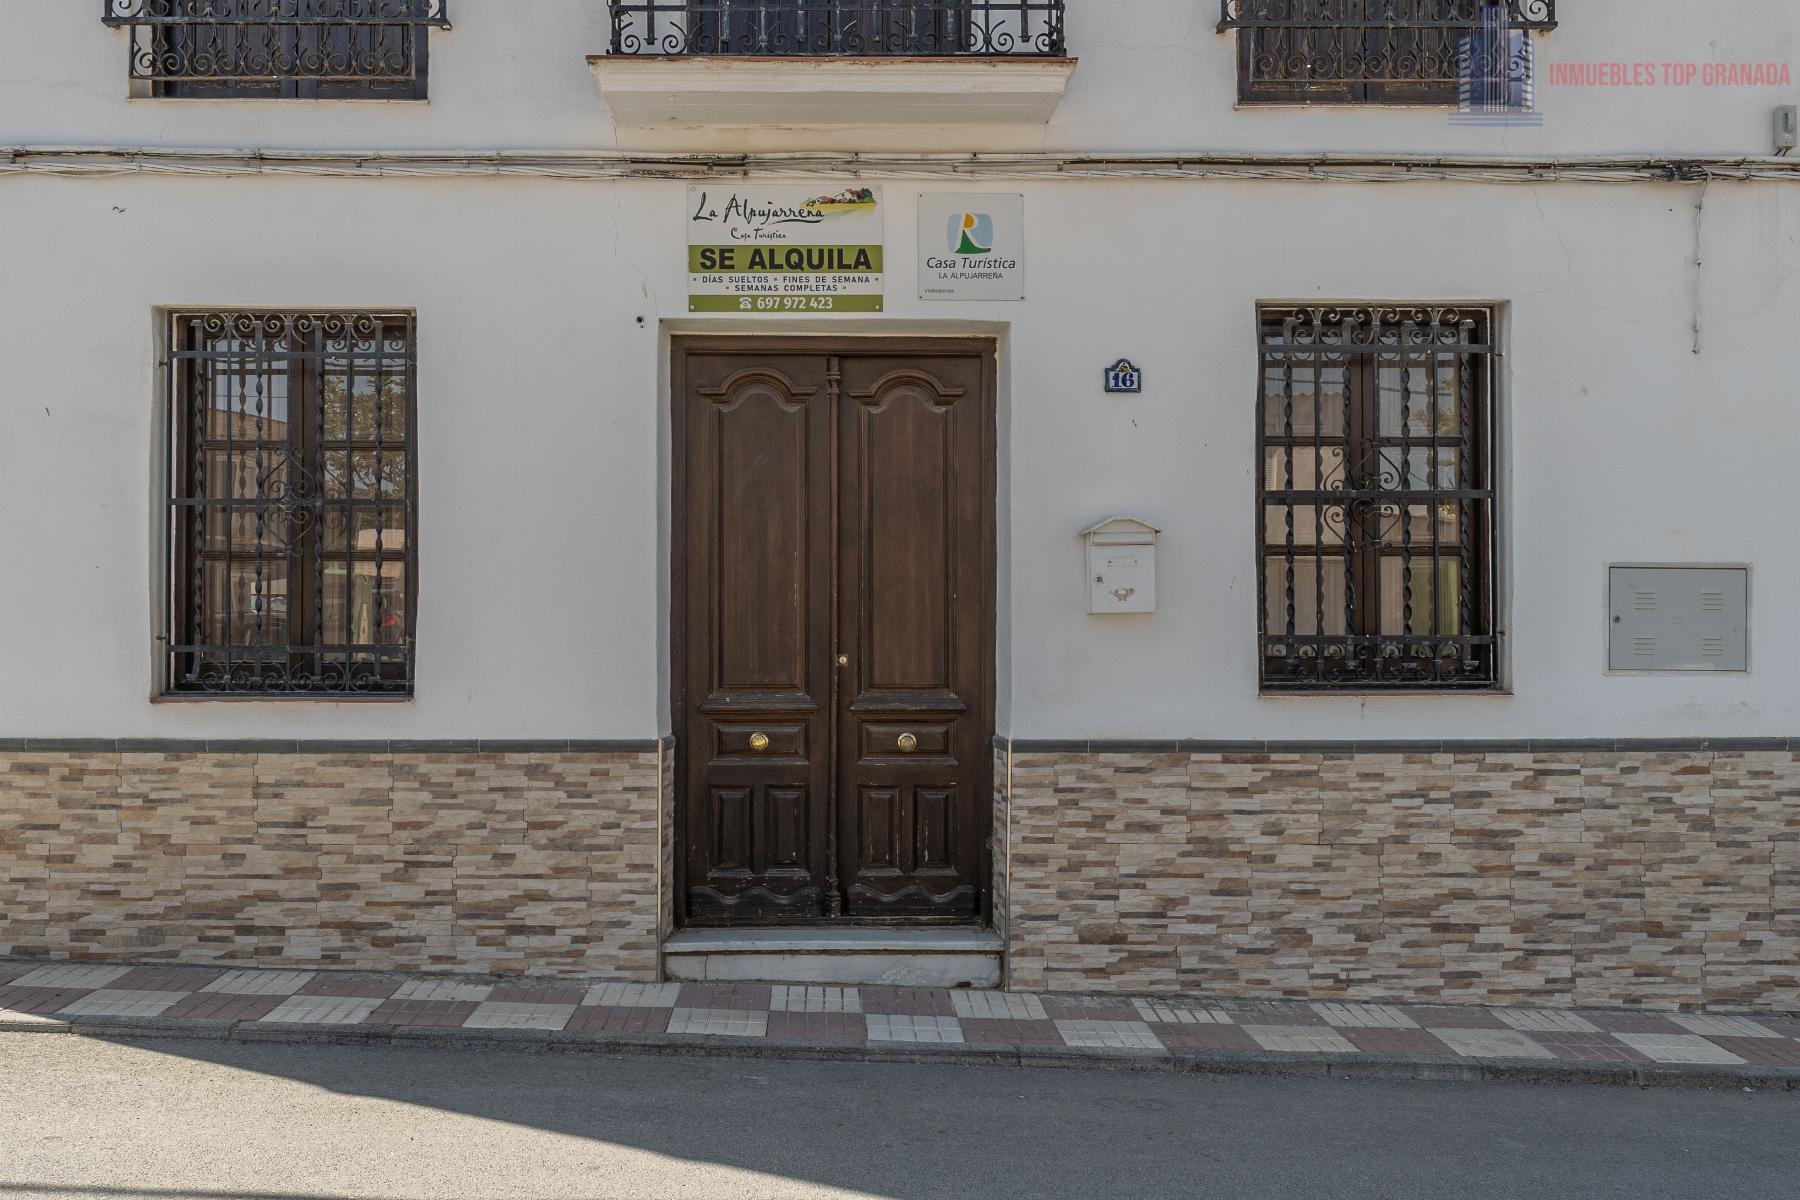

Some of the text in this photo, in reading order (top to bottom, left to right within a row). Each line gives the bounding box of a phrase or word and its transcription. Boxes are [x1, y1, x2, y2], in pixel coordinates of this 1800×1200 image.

[692, 192, 718, 221] La
[730, 227, 751, 241] Casa
[700, 248, 872, 272] SE ALQUILA
[926, 257, 1016, 269] Casa Turística
[702, 274, 724, 283] DÍAS
[734, 284, 838, 292] SEMANAS COMPLETAS
[757, 297, 833, 310] 697 972 423
[1111, 372, 1134, 387] 16
